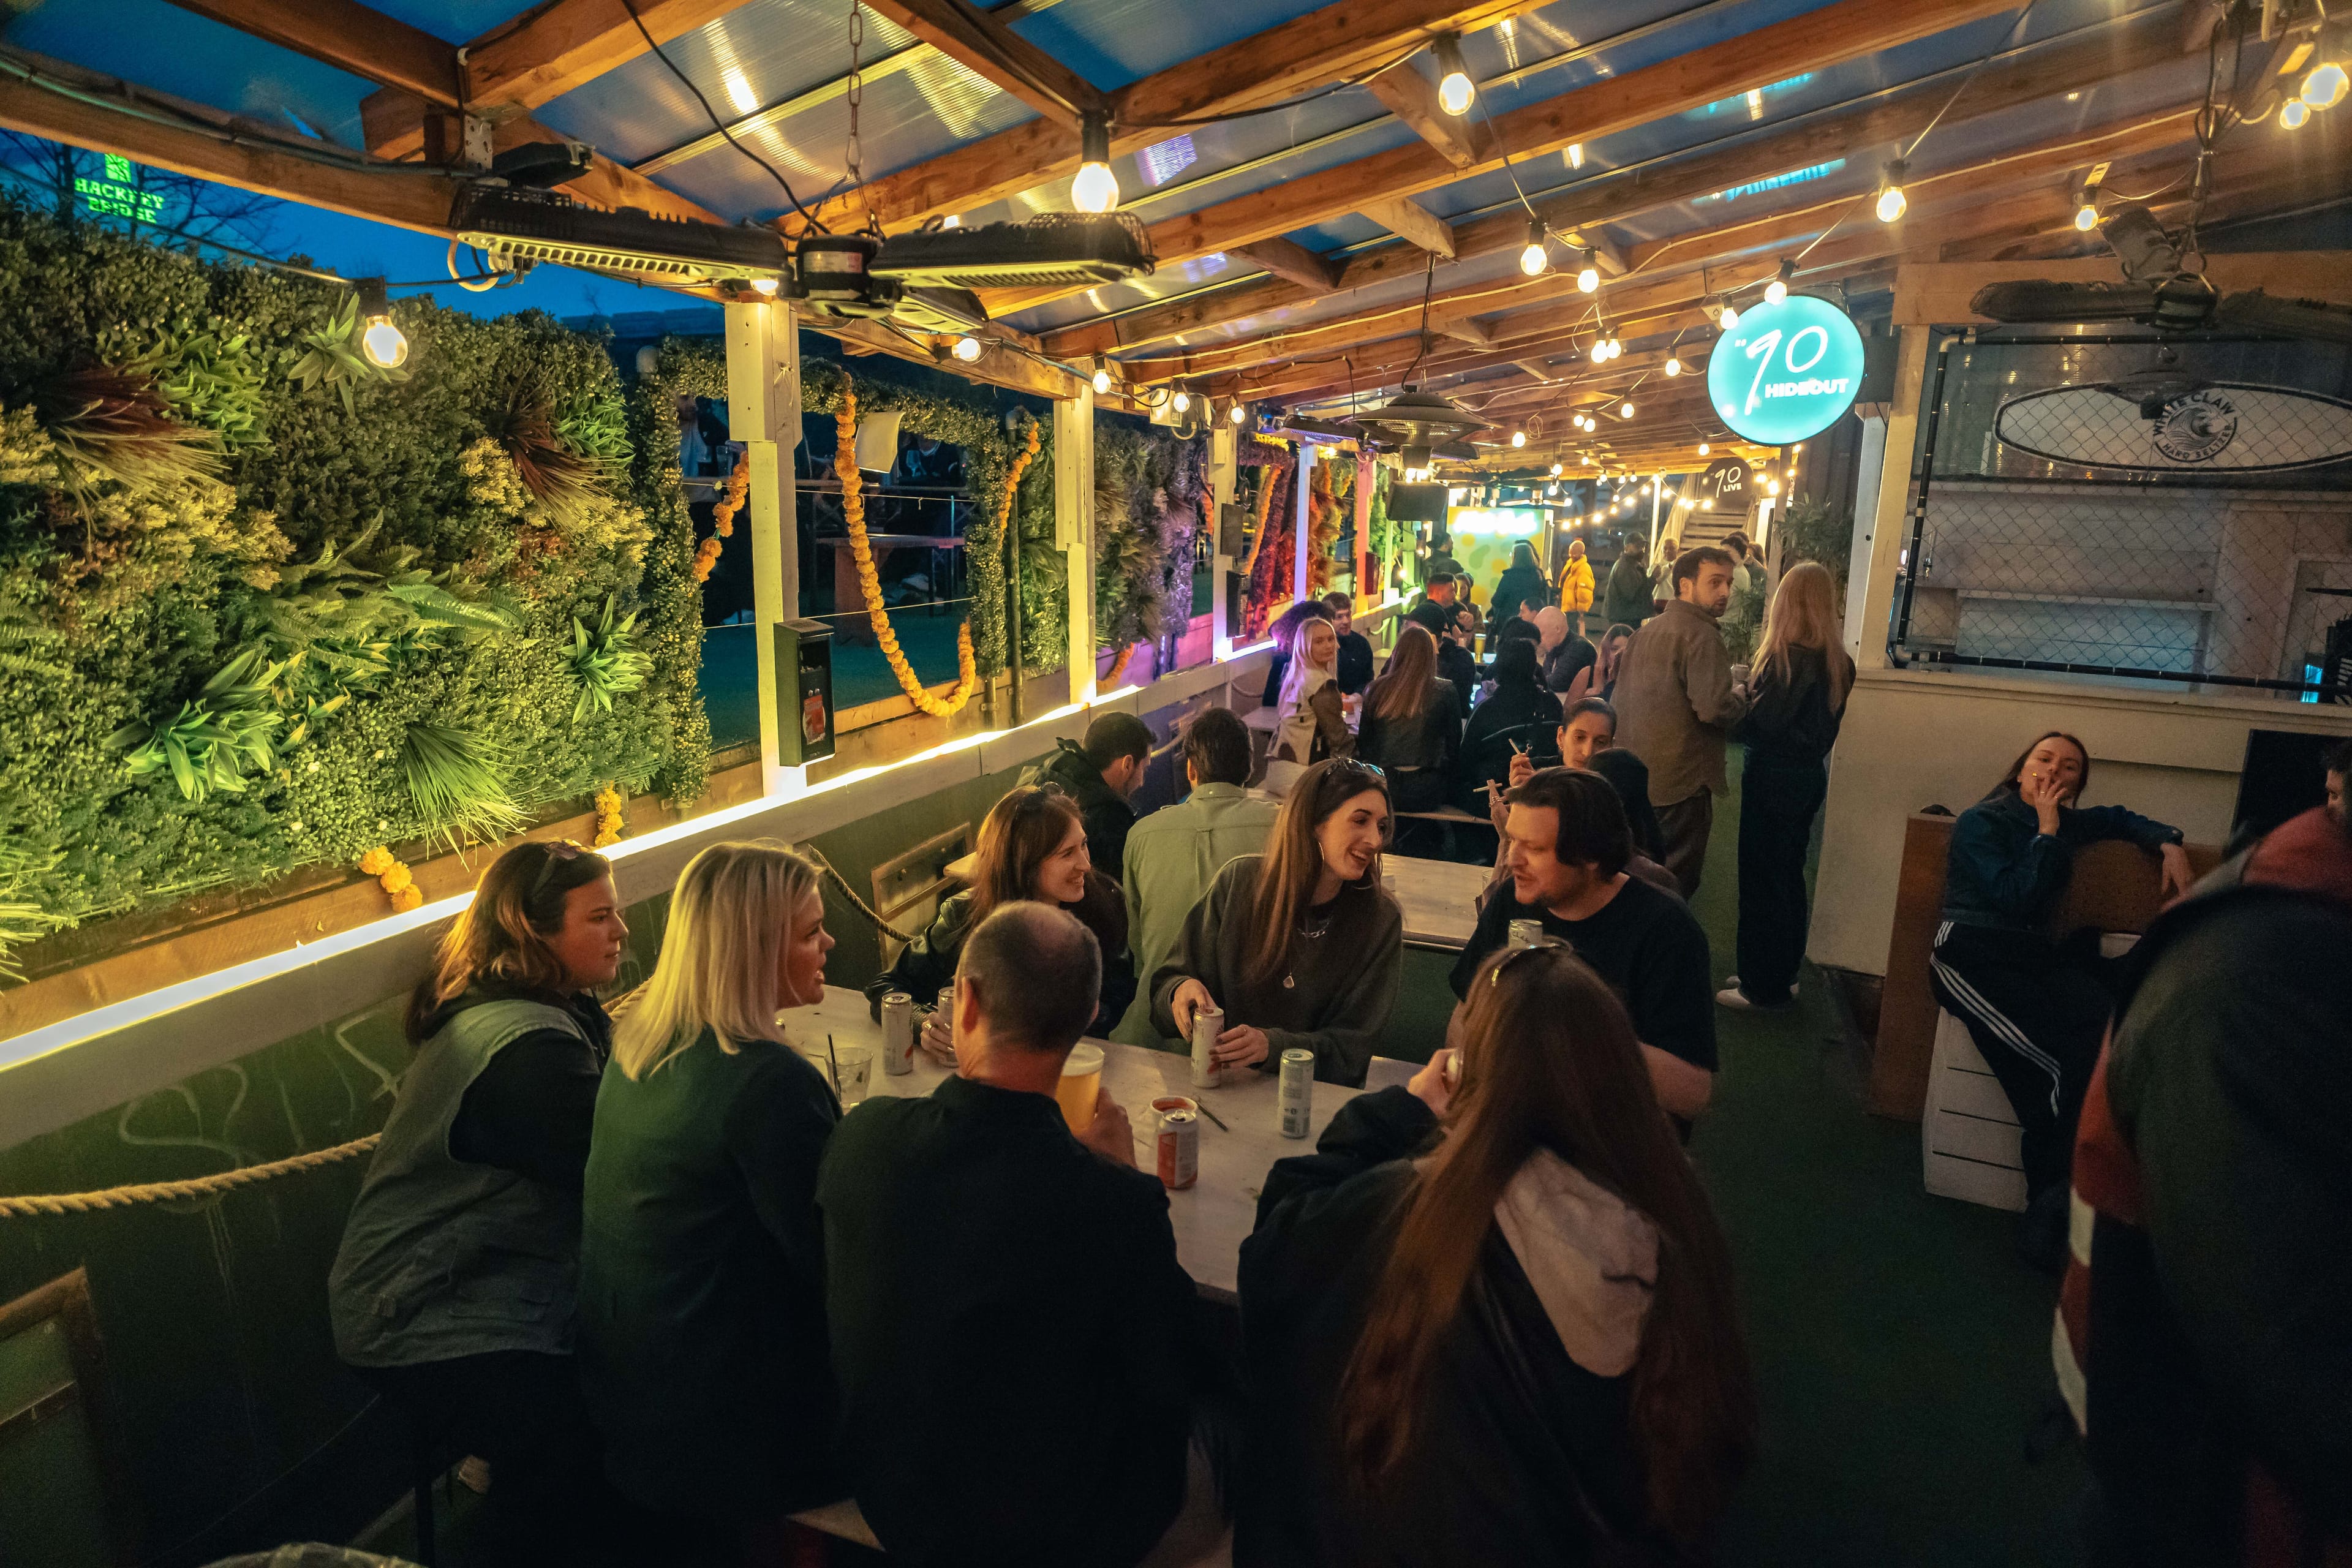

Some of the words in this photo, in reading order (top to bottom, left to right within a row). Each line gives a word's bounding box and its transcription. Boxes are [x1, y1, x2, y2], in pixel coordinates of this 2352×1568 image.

[1765, 379, 1849, 398] HIDEOUT
[2153, 398, 2187, 436] WHITE
[2191, 393, 2235, 415] CLAW
[2162, 443, 2190, 459] HARD
[2196, 425, 2233, 458] SELTZER
[1723, 483, 1742, 492] LIVE
